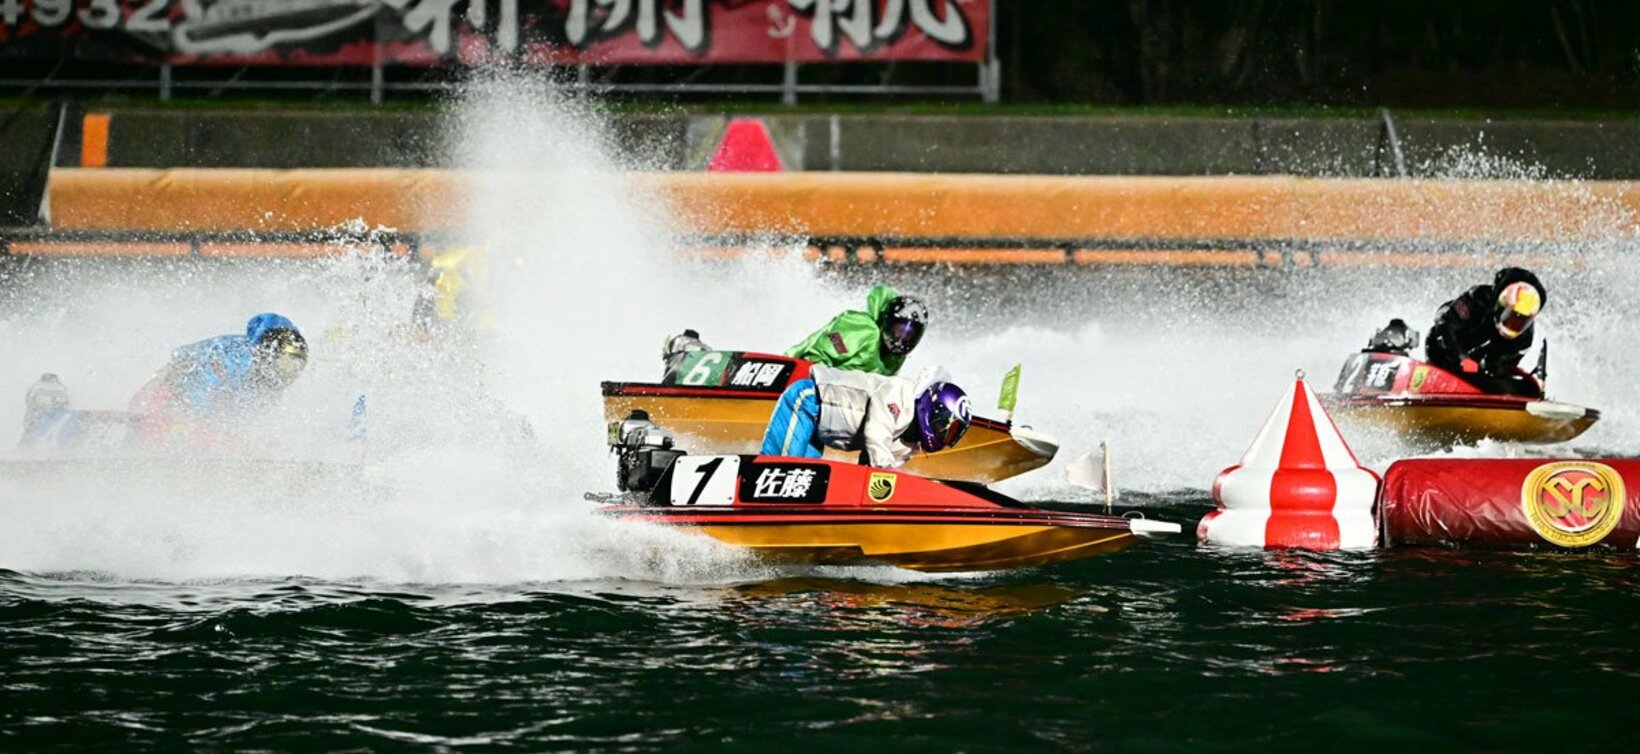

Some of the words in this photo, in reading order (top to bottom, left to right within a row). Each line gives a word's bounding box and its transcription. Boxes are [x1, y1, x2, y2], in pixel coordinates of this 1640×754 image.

[682, 352, 722, 386] 6
[731, 361, 785, 387] 船岡
[1342, 354, 1366, 393] 2
[686, 457, 725, 505] 1
[753, 468, 816, 498] 佐藤
[1541, 476, 1609, 518] SG
